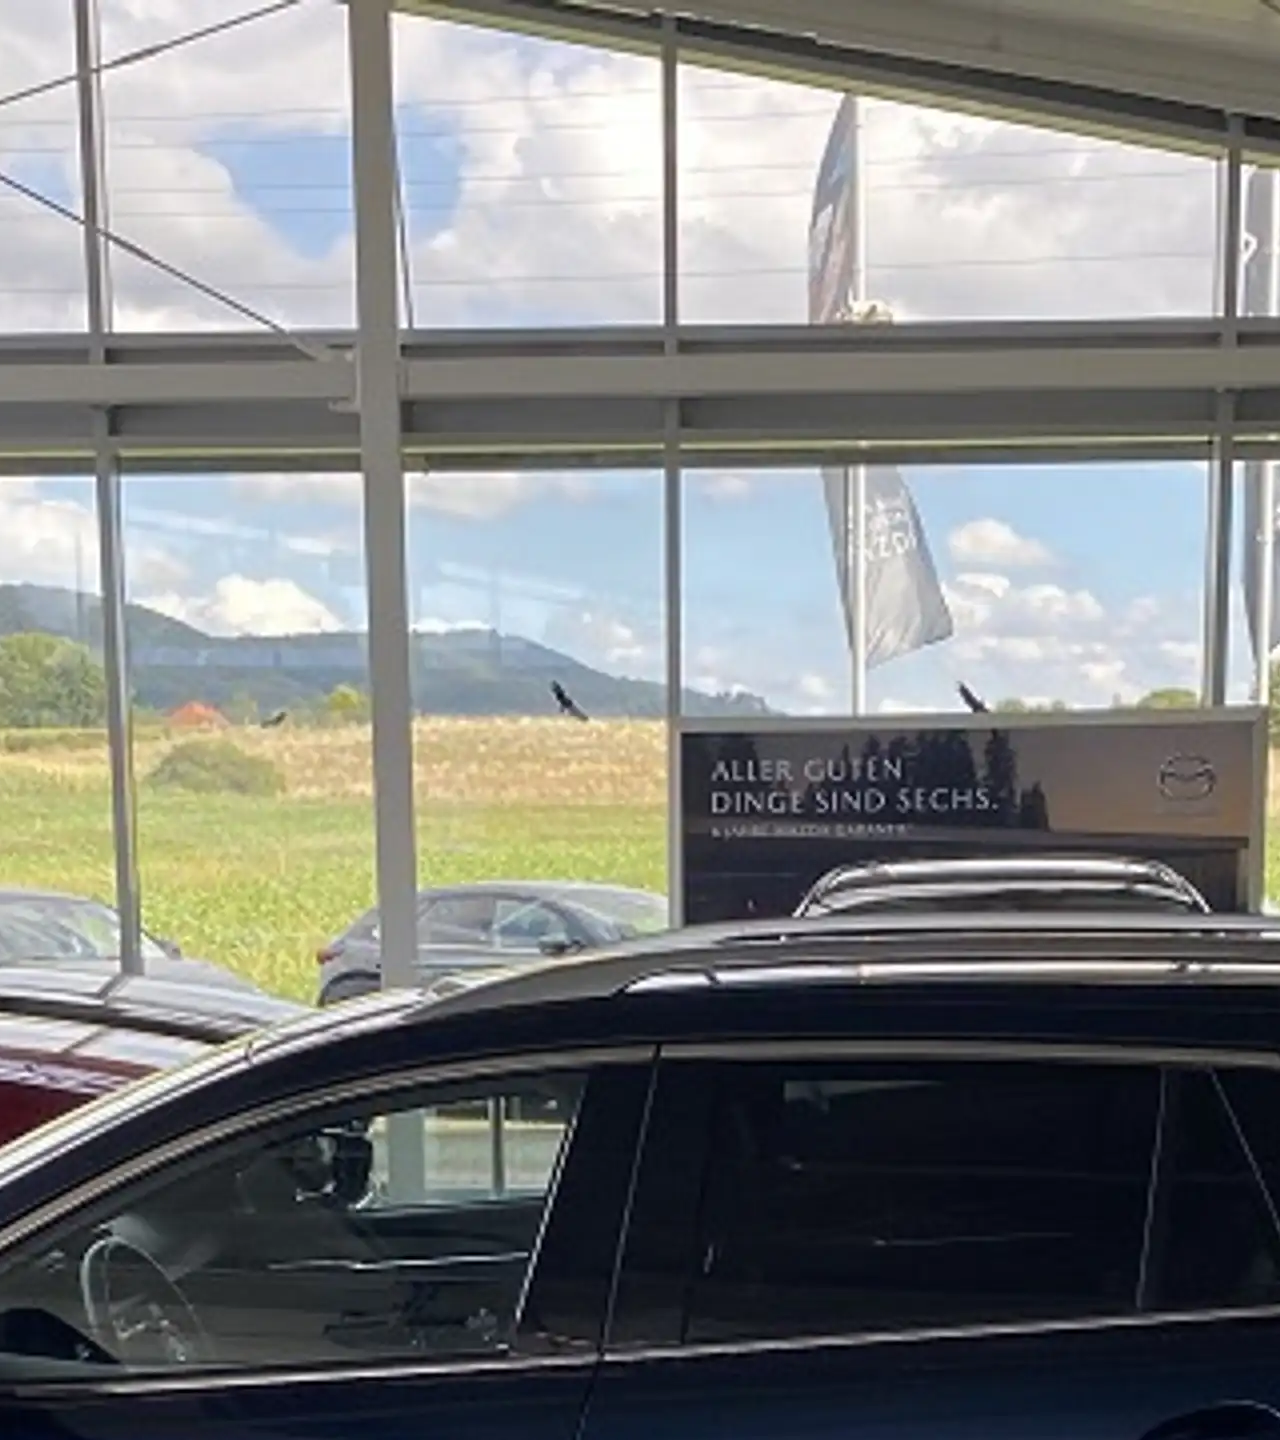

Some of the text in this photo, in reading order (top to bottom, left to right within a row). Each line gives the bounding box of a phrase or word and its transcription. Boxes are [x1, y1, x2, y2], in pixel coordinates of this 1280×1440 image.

[710, 757, 903, 782] ALLER GUTEN
[710, 787, 1000, 814] DINGE SIND SECHS.
